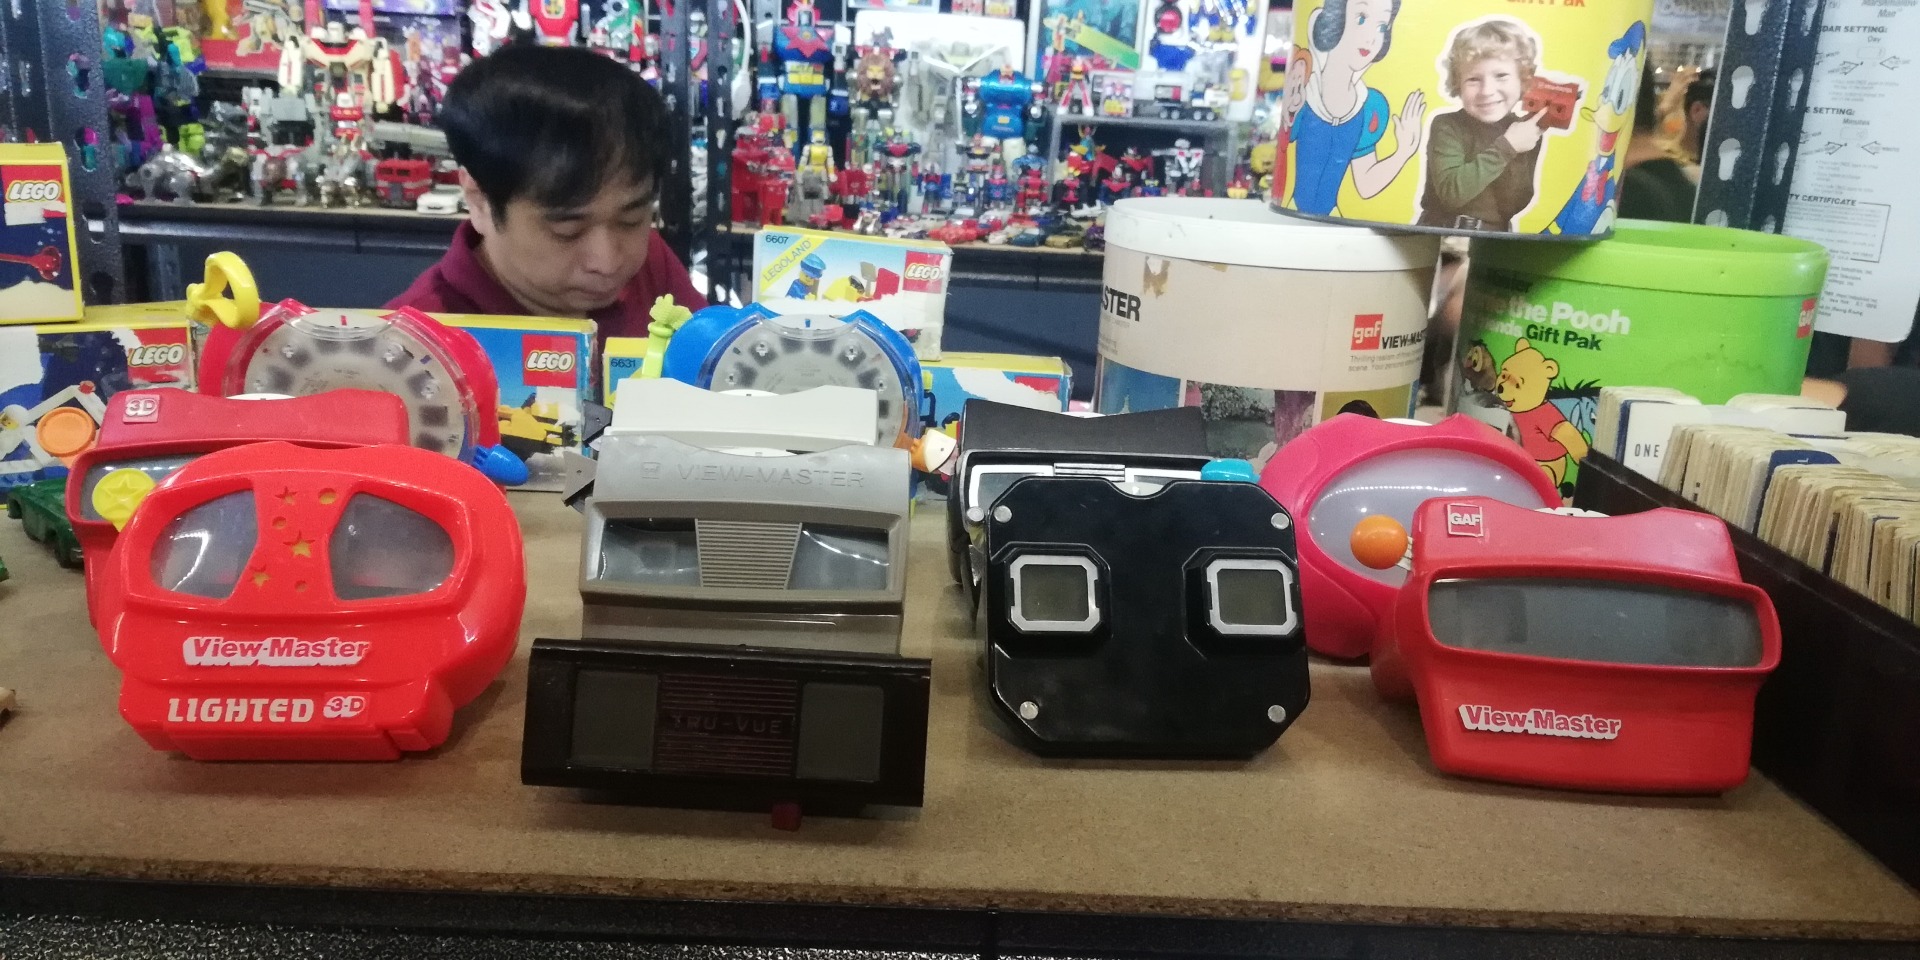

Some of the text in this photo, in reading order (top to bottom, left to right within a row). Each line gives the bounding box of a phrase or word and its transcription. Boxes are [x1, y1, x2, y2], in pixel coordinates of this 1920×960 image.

[1843, 25, 1888, 34] SETTING:
[1867, 35, 1881, 43] Day
[1813, 106, 1856, 116] SETTING:
[8, 182, 60, 200] LEGO
[1801, 194, 1857, 207] CERTIFICATE
[765, 234, 789, 245] 6607
[762, 238, 812, 283] LEGOLAND
[905, 262, 942, 281] LEGO
[1101, 285, 1141, 322] STER
[1550, 301, 1631, 335] Pooh
[1353, 320, 1382, 344] gaf
[1526, 324, 1560, 345] Gift
[1563, 330, 1603, 351] Pak
[131, 345, 184, 365] LEGO
[526, 351, 573, 371] LEGO
[610, 358, 636, 369] 6631
[125, 398, 157, 417] 3D
[1634, 443, 1660, 458] ONE
[677, 463, 865, 488] VIEW-MASTER
[1450, 512, 1480, 526] GAF
[191, 637, 370, 661] View-Master
[167, 696, 366, 723] LIGHTED 3-D
[671, 713, 783, 734] TRU-VUE
[1462, 705, 1620, 737] View-Master
